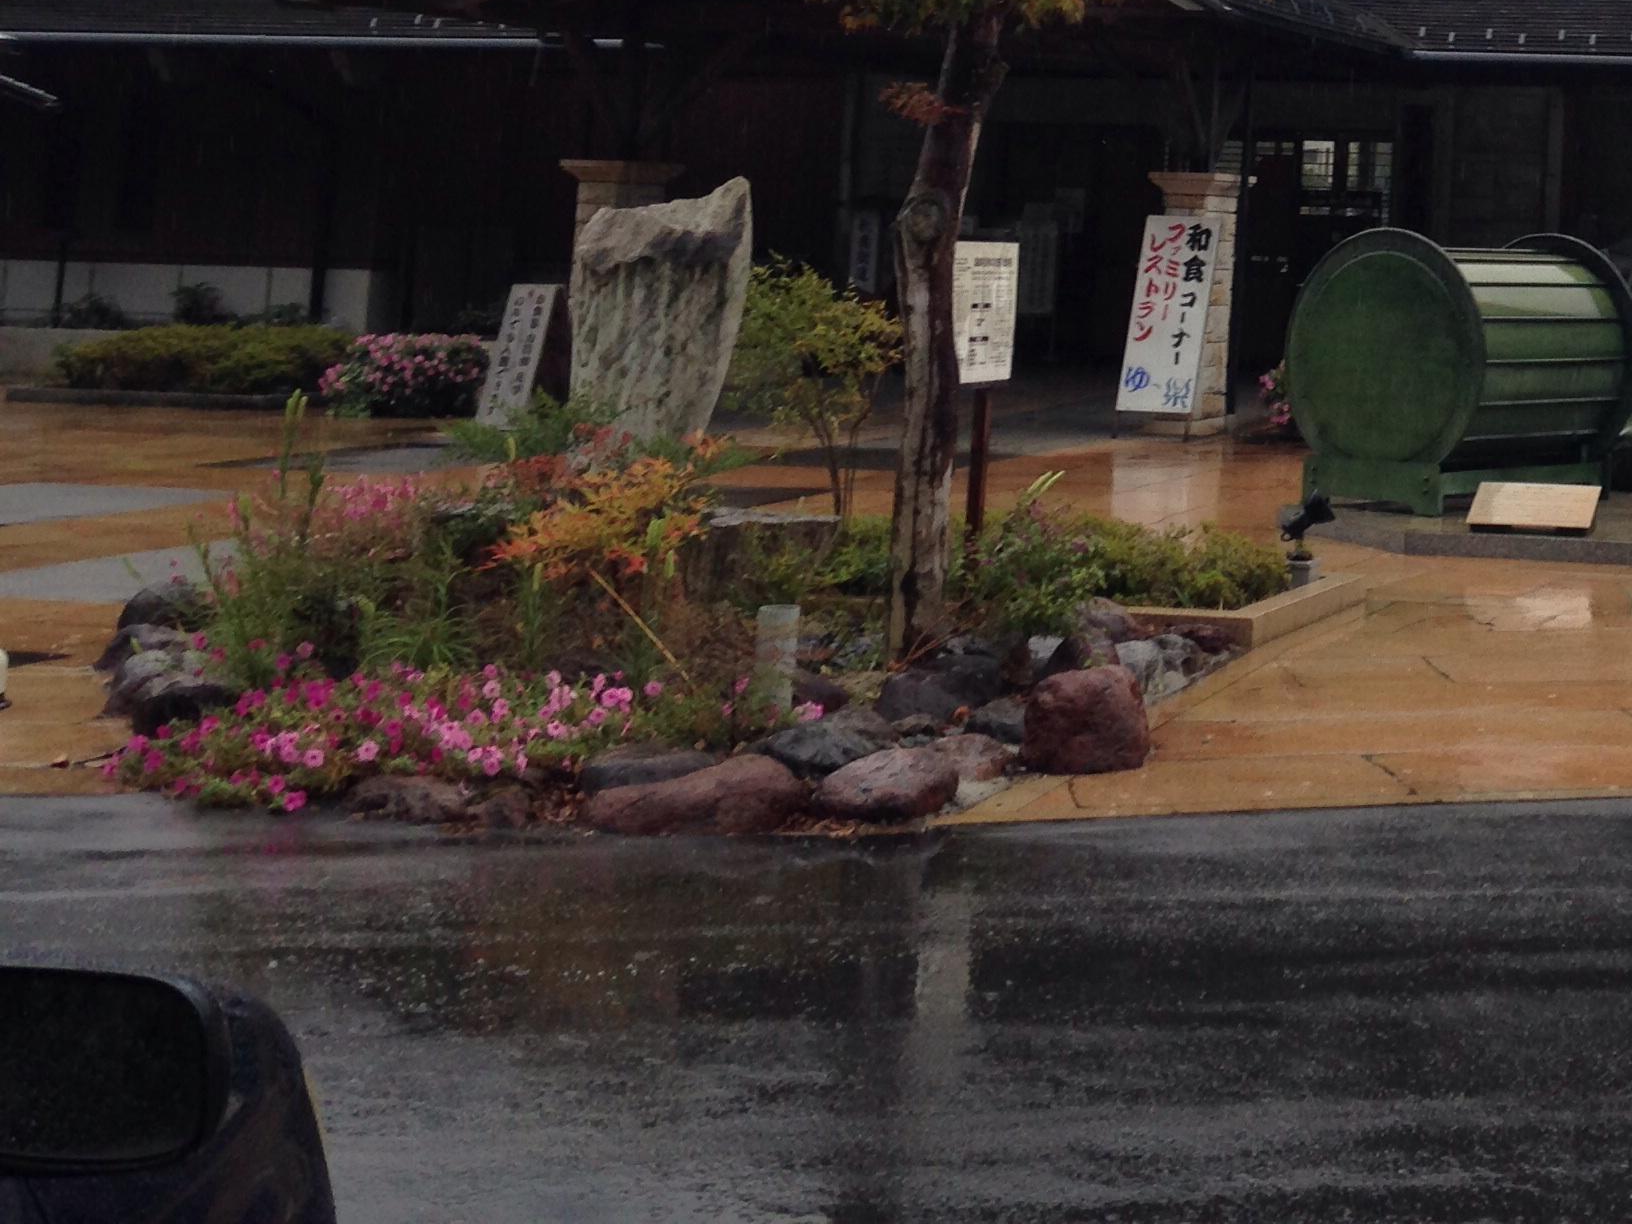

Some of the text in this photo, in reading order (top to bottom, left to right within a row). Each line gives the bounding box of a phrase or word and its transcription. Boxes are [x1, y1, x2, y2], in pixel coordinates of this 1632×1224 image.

[1133, 233, 1166, 341] レストラン
[1161, 223, 1185, 320] ファミリー
[1172, 223, 1212, 365] 和食コーナー
